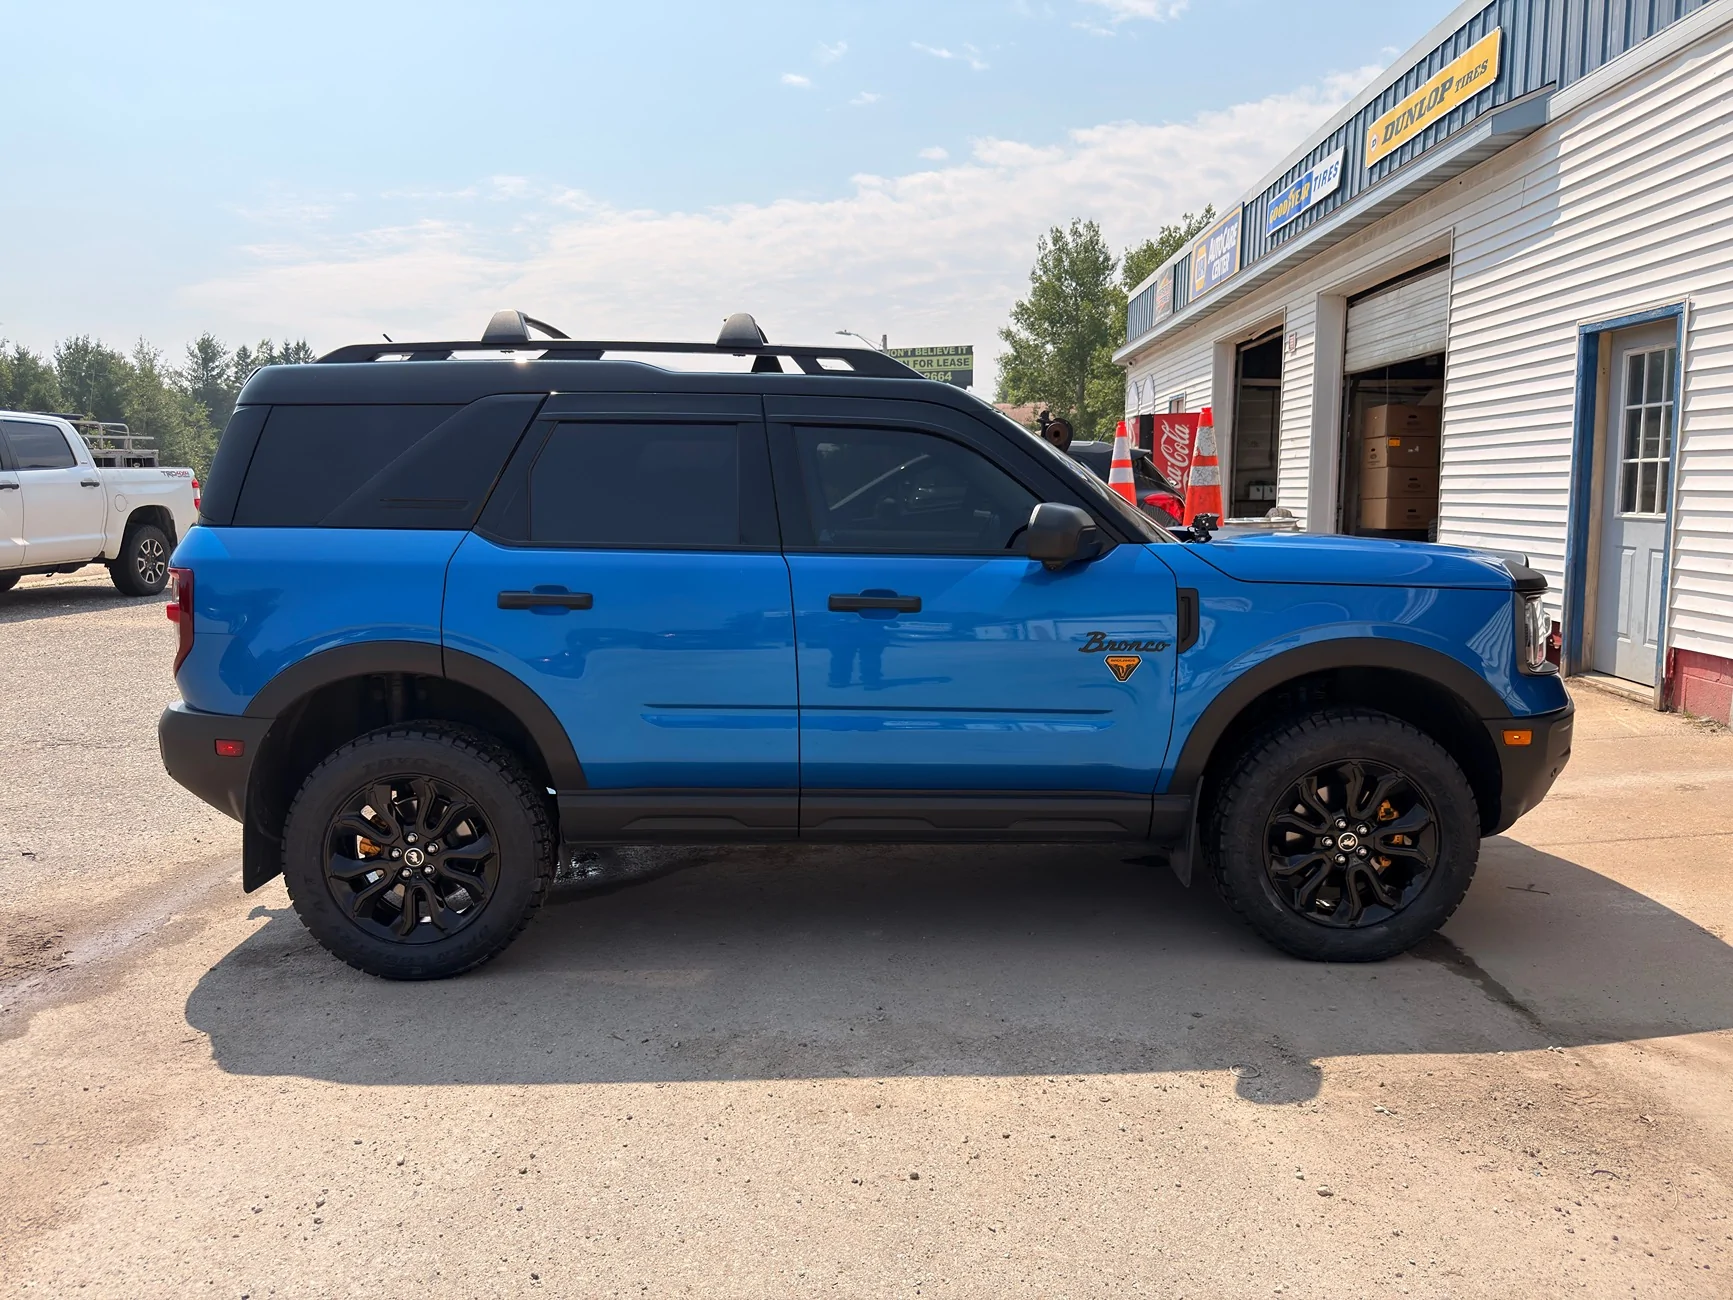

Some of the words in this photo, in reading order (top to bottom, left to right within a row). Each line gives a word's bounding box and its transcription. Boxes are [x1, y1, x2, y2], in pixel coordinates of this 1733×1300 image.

[1381, 76, 1455, 146] DUNLOP
[1454, 59, 1489, 94] TIRES
[1313, 160, 1340, 193] TIRES
[1211, 252, 1231, 281] CENTER
[913, 359, 933, 368] FOR
[937, 358, 970, 367] LEASE
[915, 346, 956, 356] BELIEVE
[958, 346, 968, 355] IT
[1078, 631, 1171, 653] Bronco
